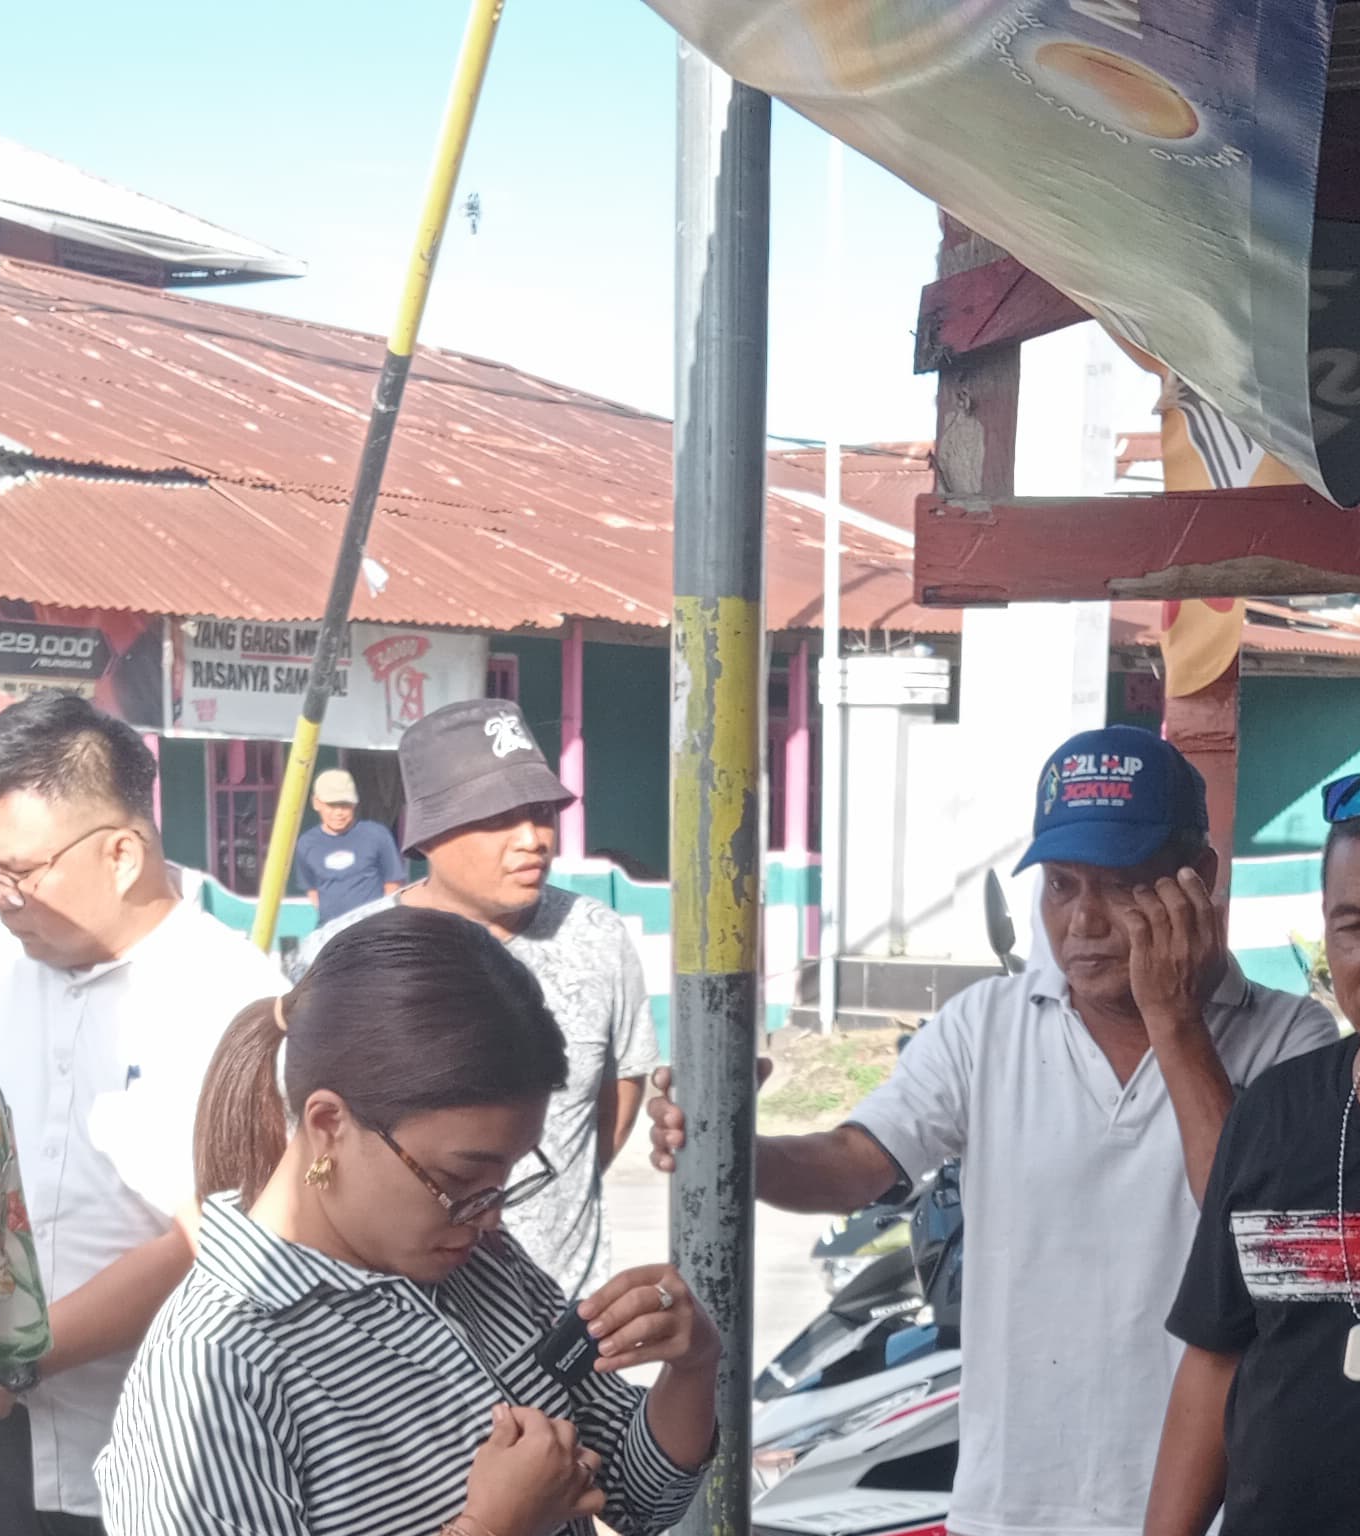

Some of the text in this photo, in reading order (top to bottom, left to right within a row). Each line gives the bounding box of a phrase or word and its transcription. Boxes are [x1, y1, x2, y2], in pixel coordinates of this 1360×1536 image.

[1035, 91, 1129, 144] MINT
[240, 623, 290, 655] GARIS
[191, 659, 270, 693] RASANYA
[870, 1298, 924, 1319] HONDA
